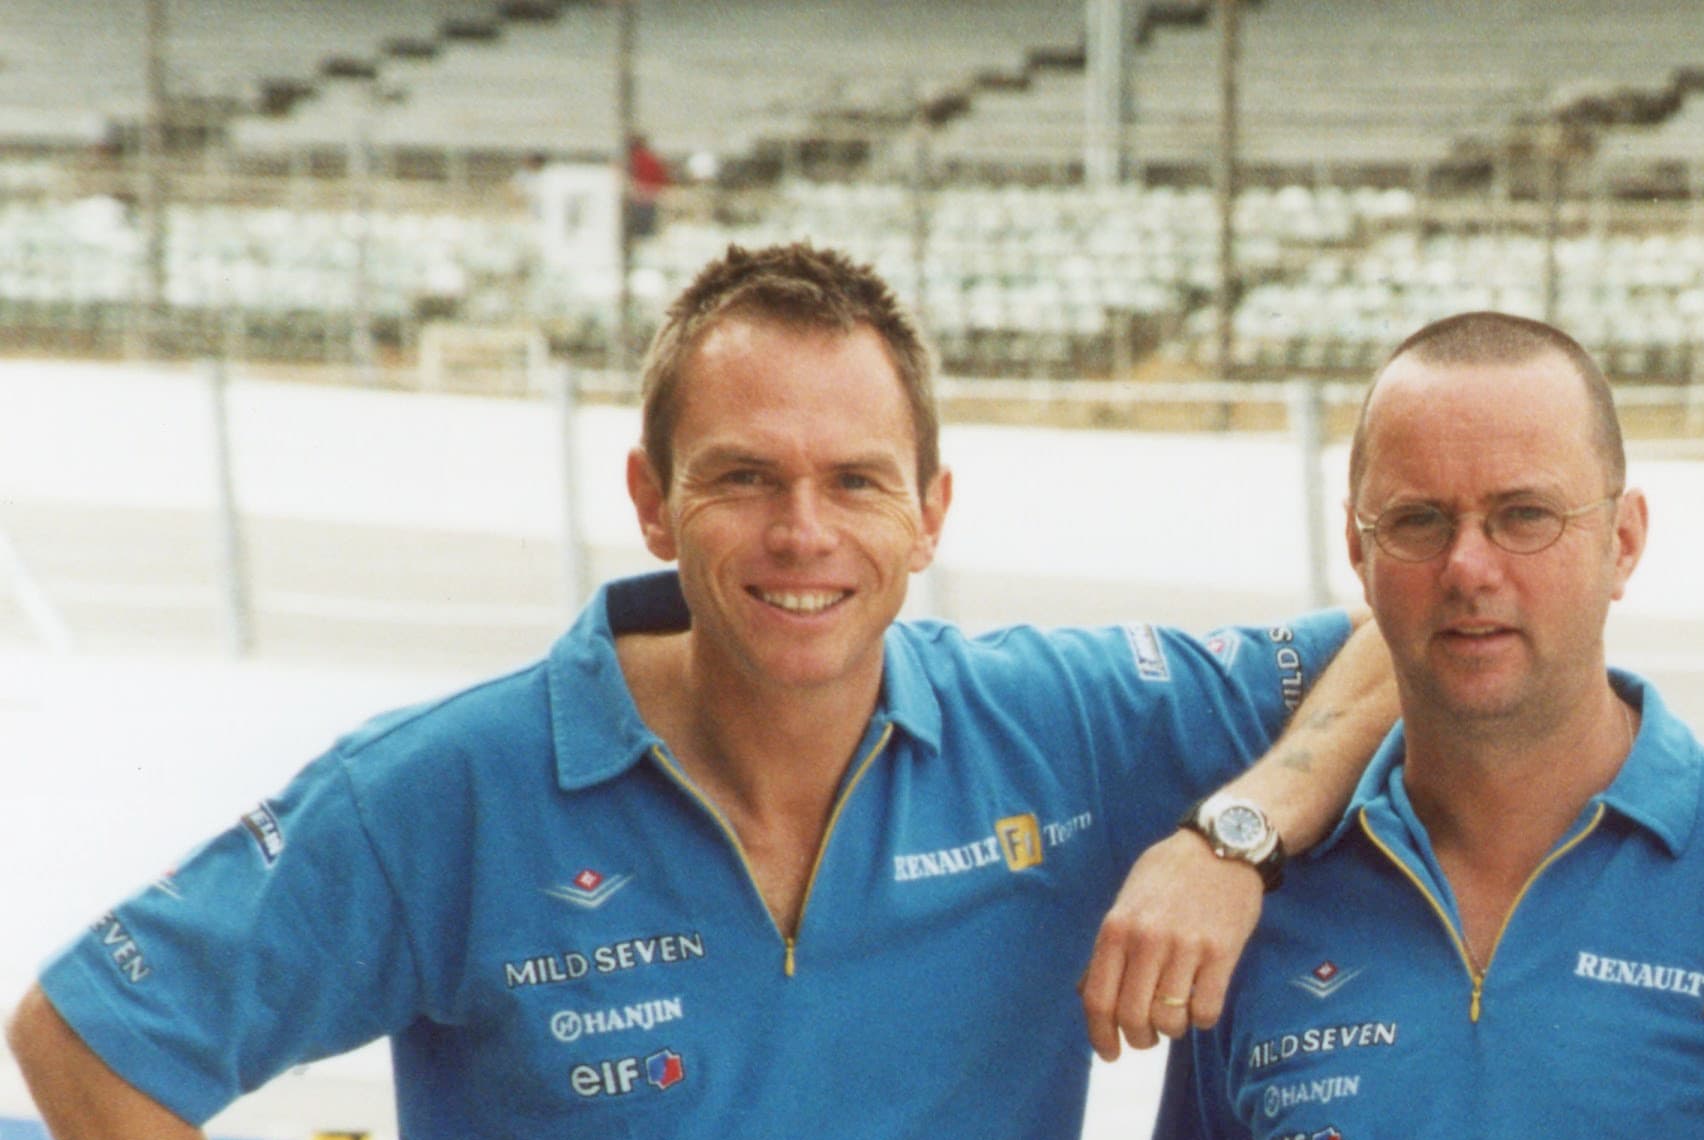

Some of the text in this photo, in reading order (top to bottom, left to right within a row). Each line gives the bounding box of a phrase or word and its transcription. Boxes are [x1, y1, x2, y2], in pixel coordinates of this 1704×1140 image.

[893, 836, 1000, 881] RENAULT
[1043, 811, 1092, 847] Team
[504, 930, 706, 988] MILD SEVEN
[582, 998, 683, 1034] HANJIN
[1301, 1021, 1397, 1053] SEVEN
[571, 1057, 639, 1096] elf
[1280, 1075, 1361, 1104] HANJIN
